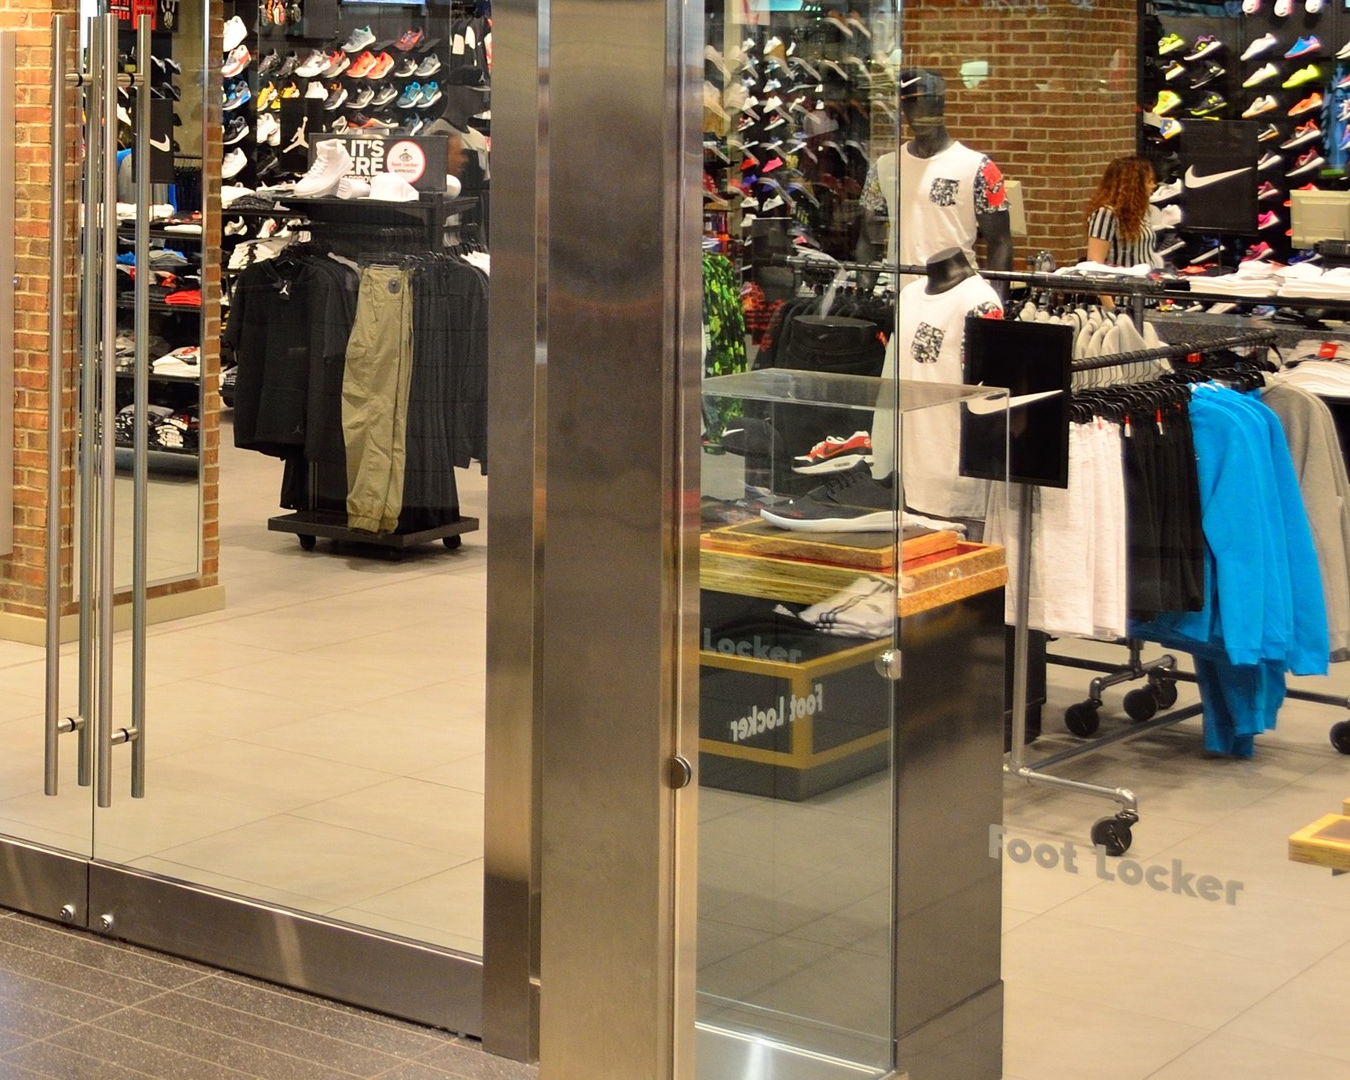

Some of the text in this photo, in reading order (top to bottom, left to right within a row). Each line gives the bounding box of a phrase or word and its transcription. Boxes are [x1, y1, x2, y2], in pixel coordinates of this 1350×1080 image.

[351, 139, 385, 157] IT'S
[703, 627, 802, 664] Locker
[988, 823, 1245, 906] Foot Locker
